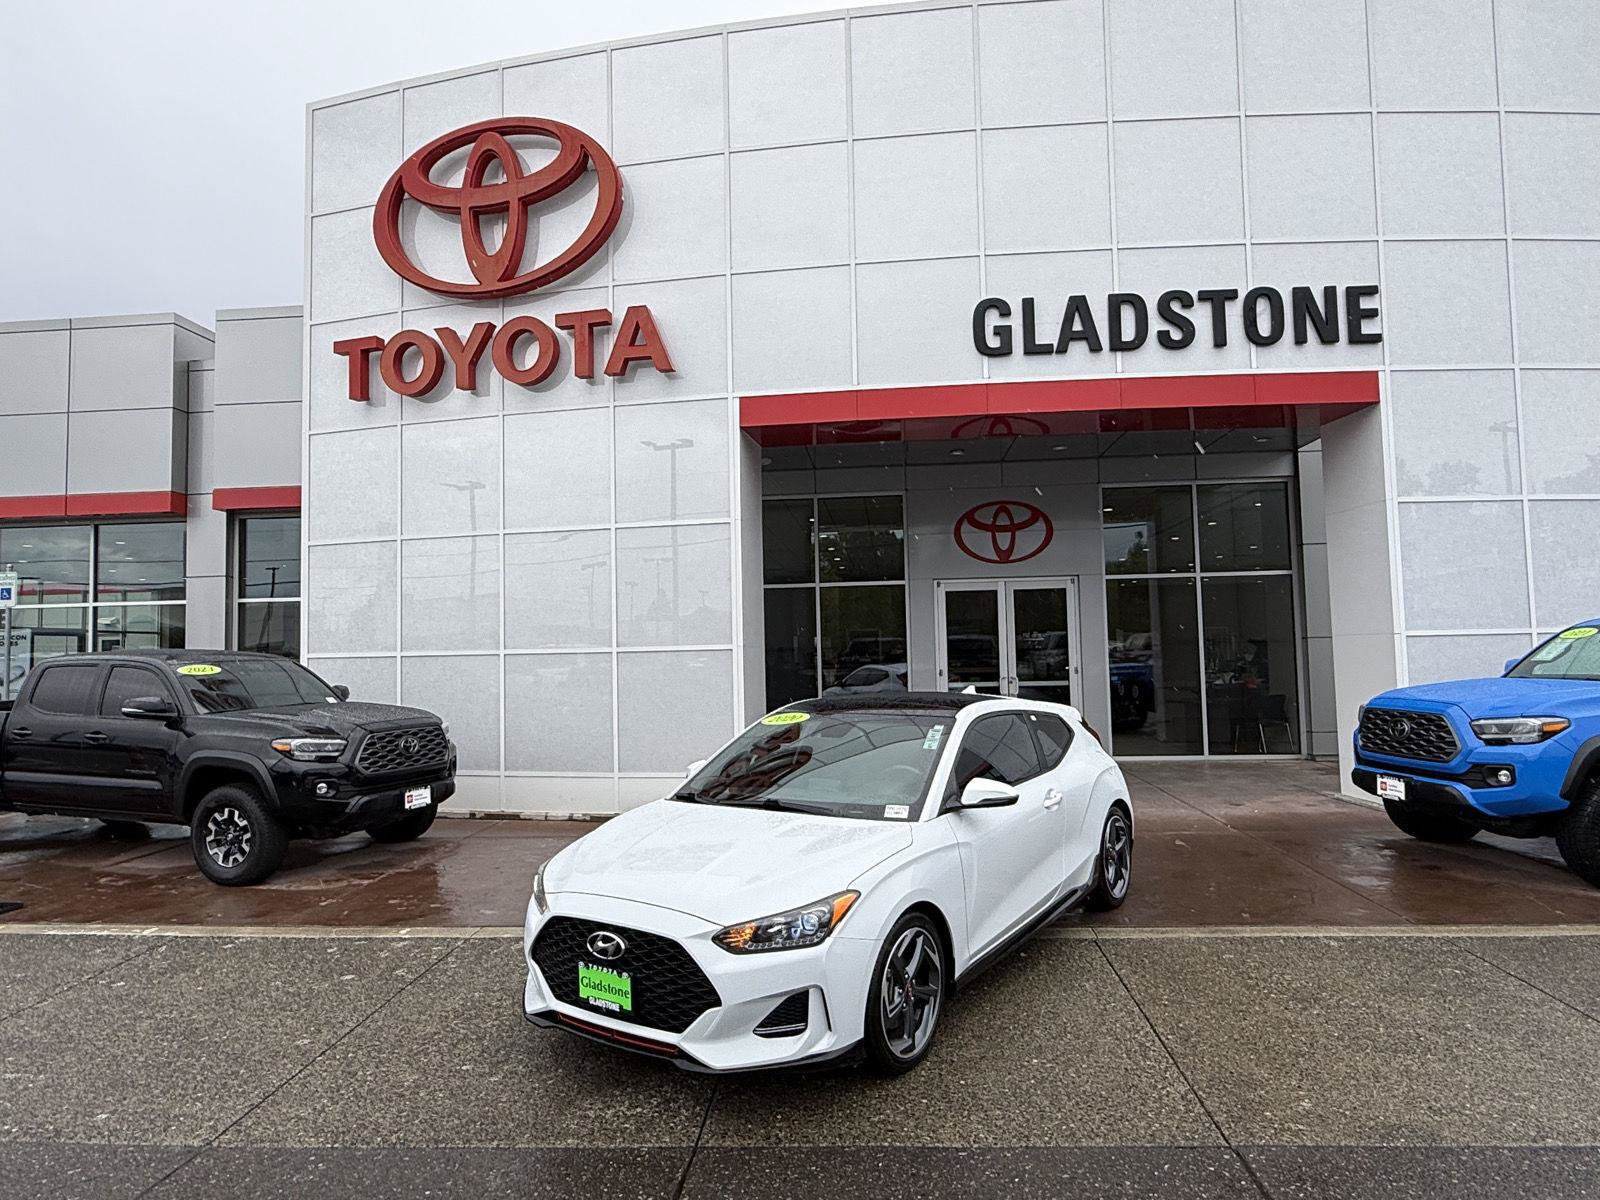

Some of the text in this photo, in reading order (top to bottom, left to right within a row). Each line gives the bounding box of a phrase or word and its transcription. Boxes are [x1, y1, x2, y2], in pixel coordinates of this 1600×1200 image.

[973, 285, 1383, 356] GLADSTONE
[333, 305, 676, 402] TOYOTA
[588, 963, 618, 976] TOYOTA
[580, 976, 630, 999] Gladstone
[588, 996, 620, 1012] GLADSTONE
